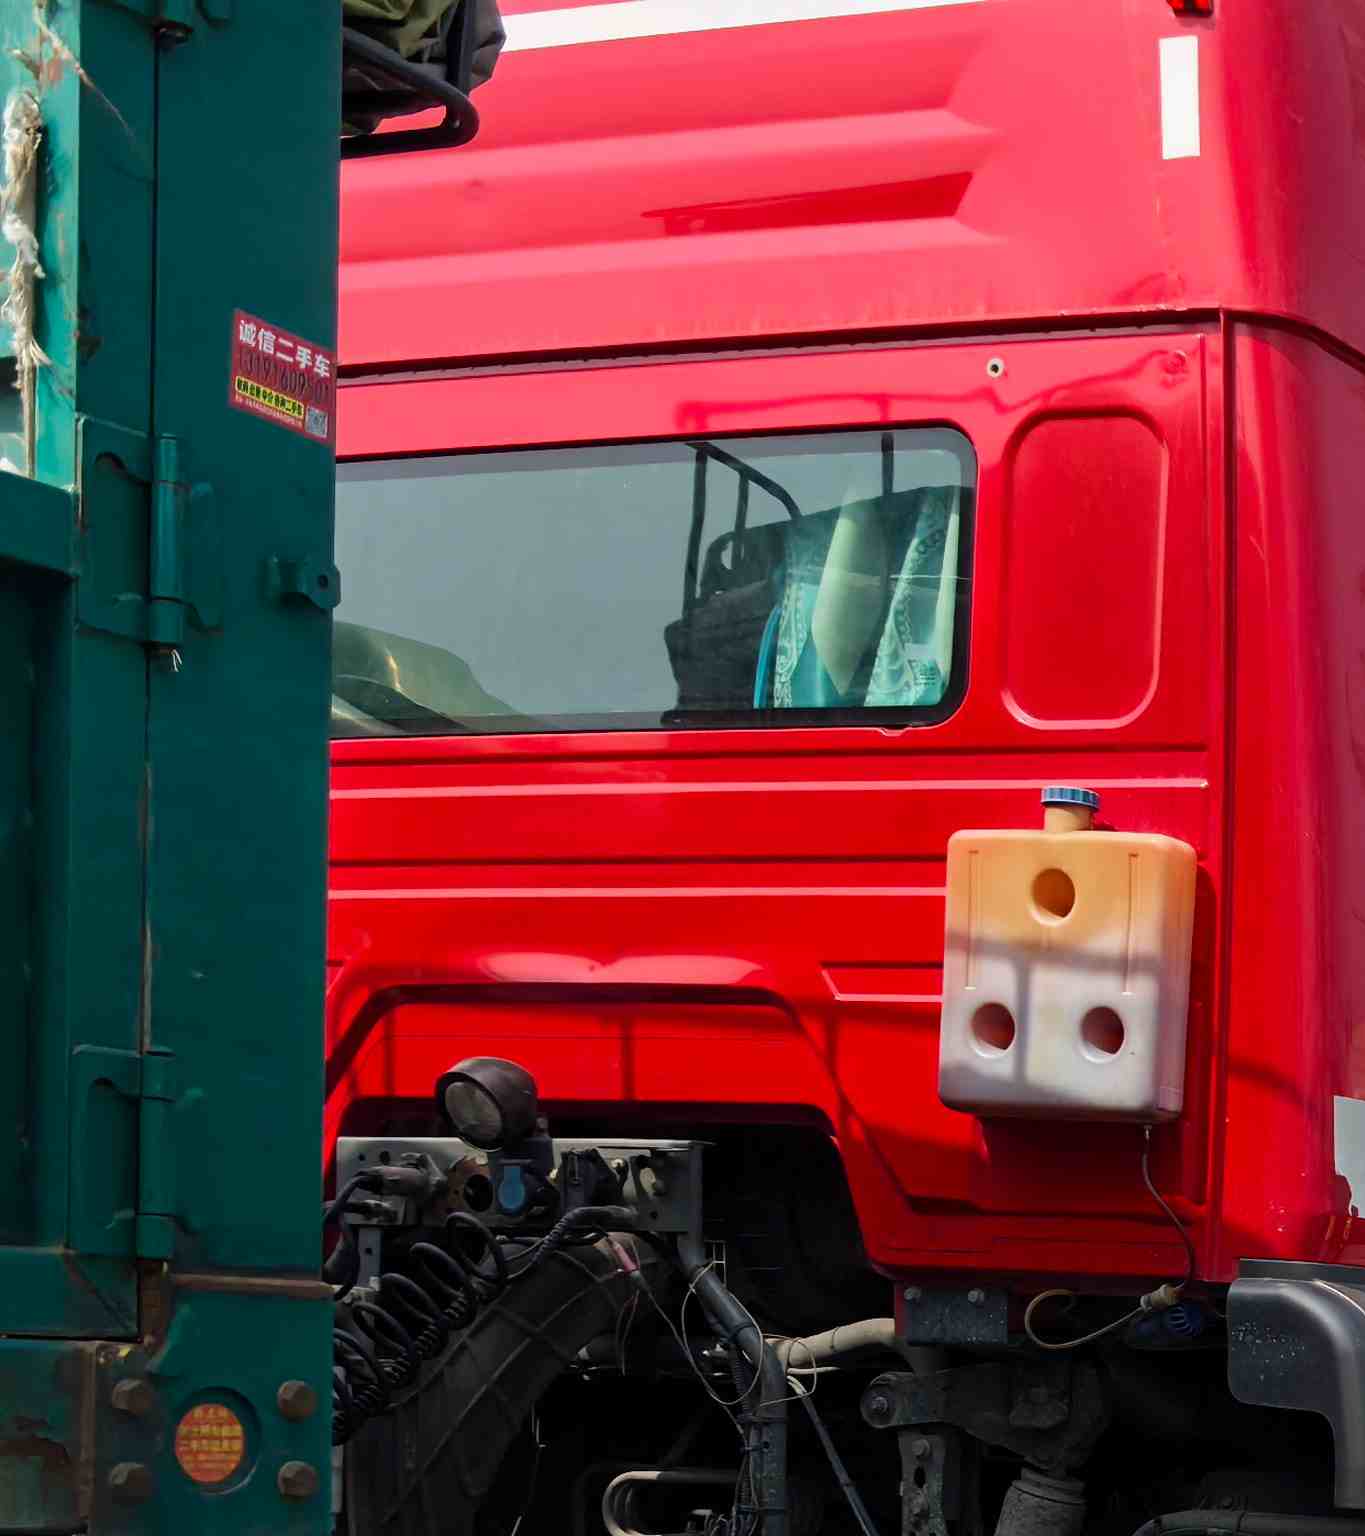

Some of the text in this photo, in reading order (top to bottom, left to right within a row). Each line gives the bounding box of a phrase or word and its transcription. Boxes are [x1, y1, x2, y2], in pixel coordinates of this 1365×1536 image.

[240, 320, 330, 377] 诚信二手车
